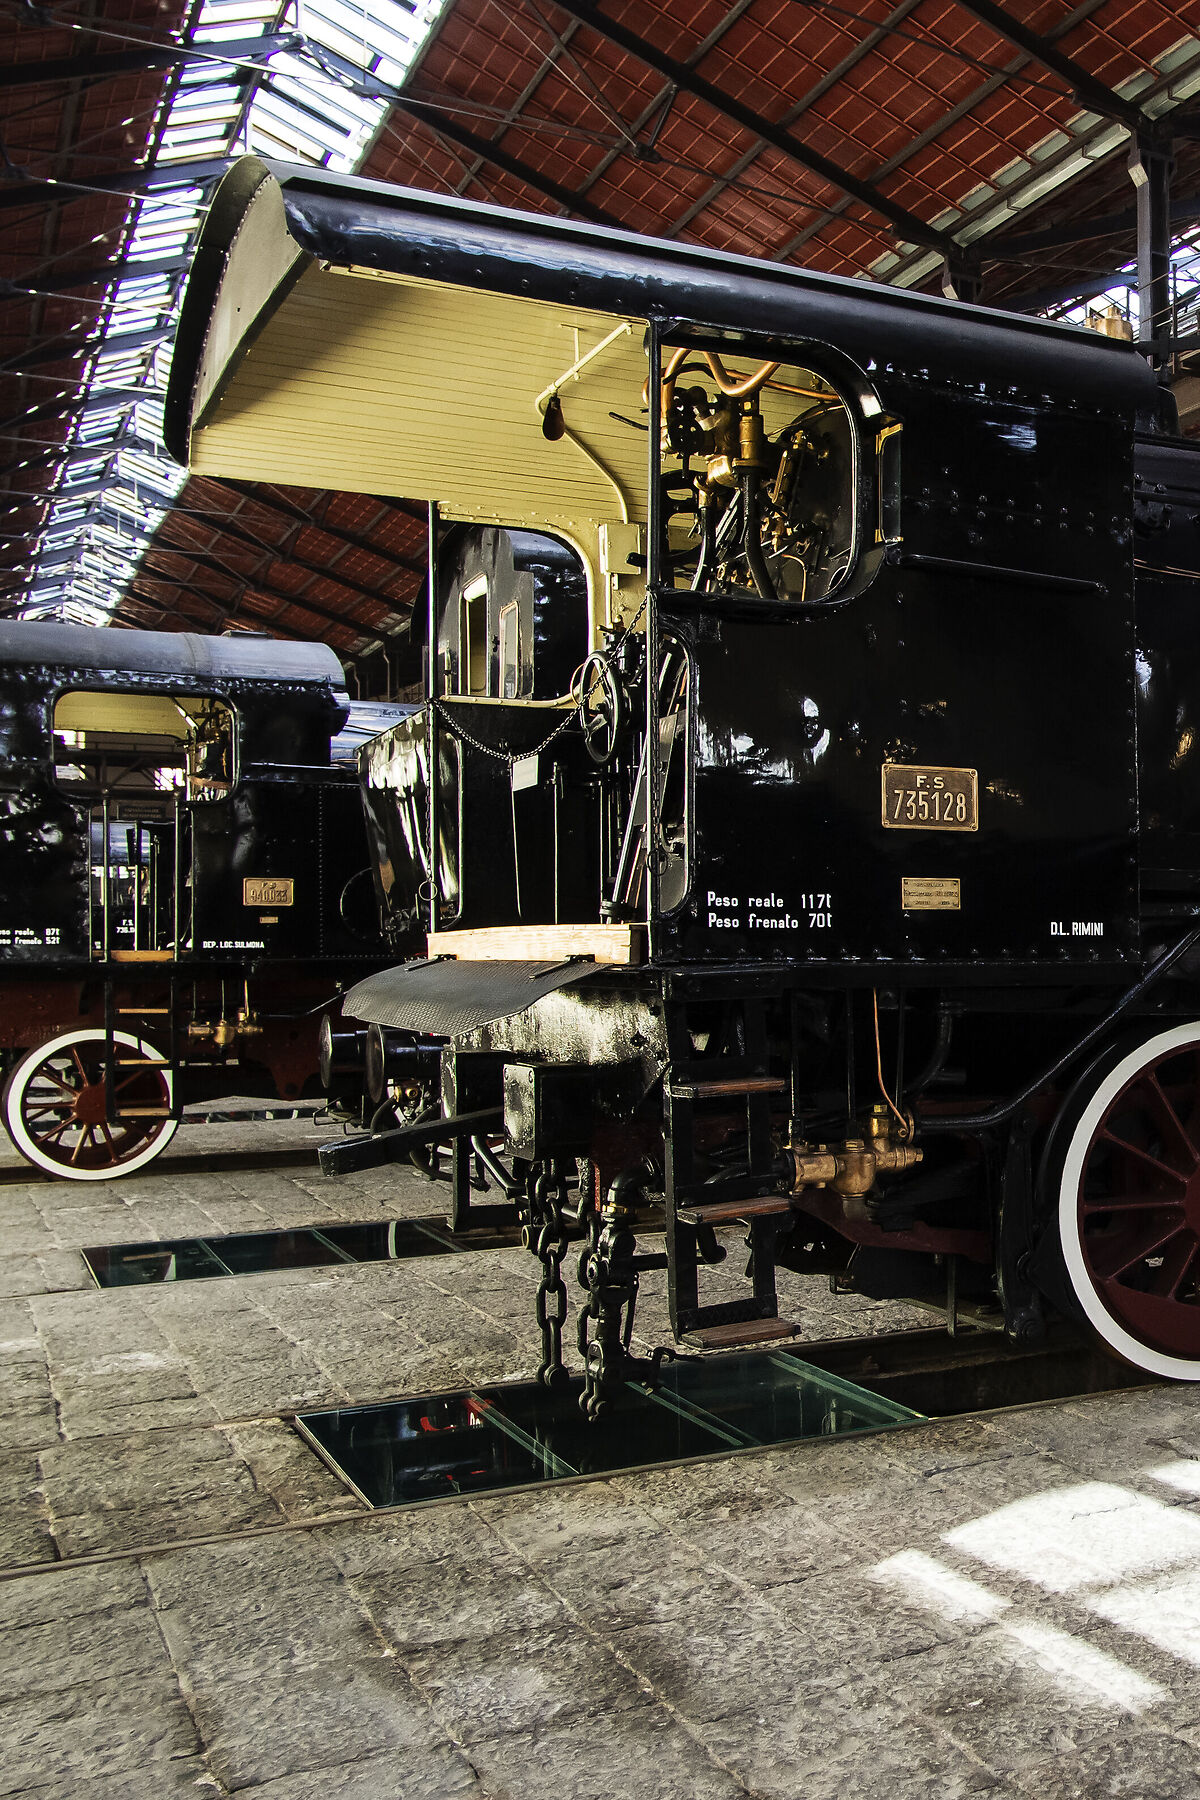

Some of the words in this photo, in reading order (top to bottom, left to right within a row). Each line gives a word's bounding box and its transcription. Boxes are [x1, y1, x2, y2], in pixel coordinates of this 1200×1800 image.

[893, 790, 967, 822] 735.128
[707, 891, 739, 907] Peso
[748, 892, 784, 908] reale
[801, 893, 832, 909] 117t
[708, 912, 740, 928] Peso
[748, 913, 799, 929] frenato
[808, 912, 833, 928] 70t
[1050, 921, 1070, 936] D.L.
[1072, 921, 1104, 936] RIMINI
